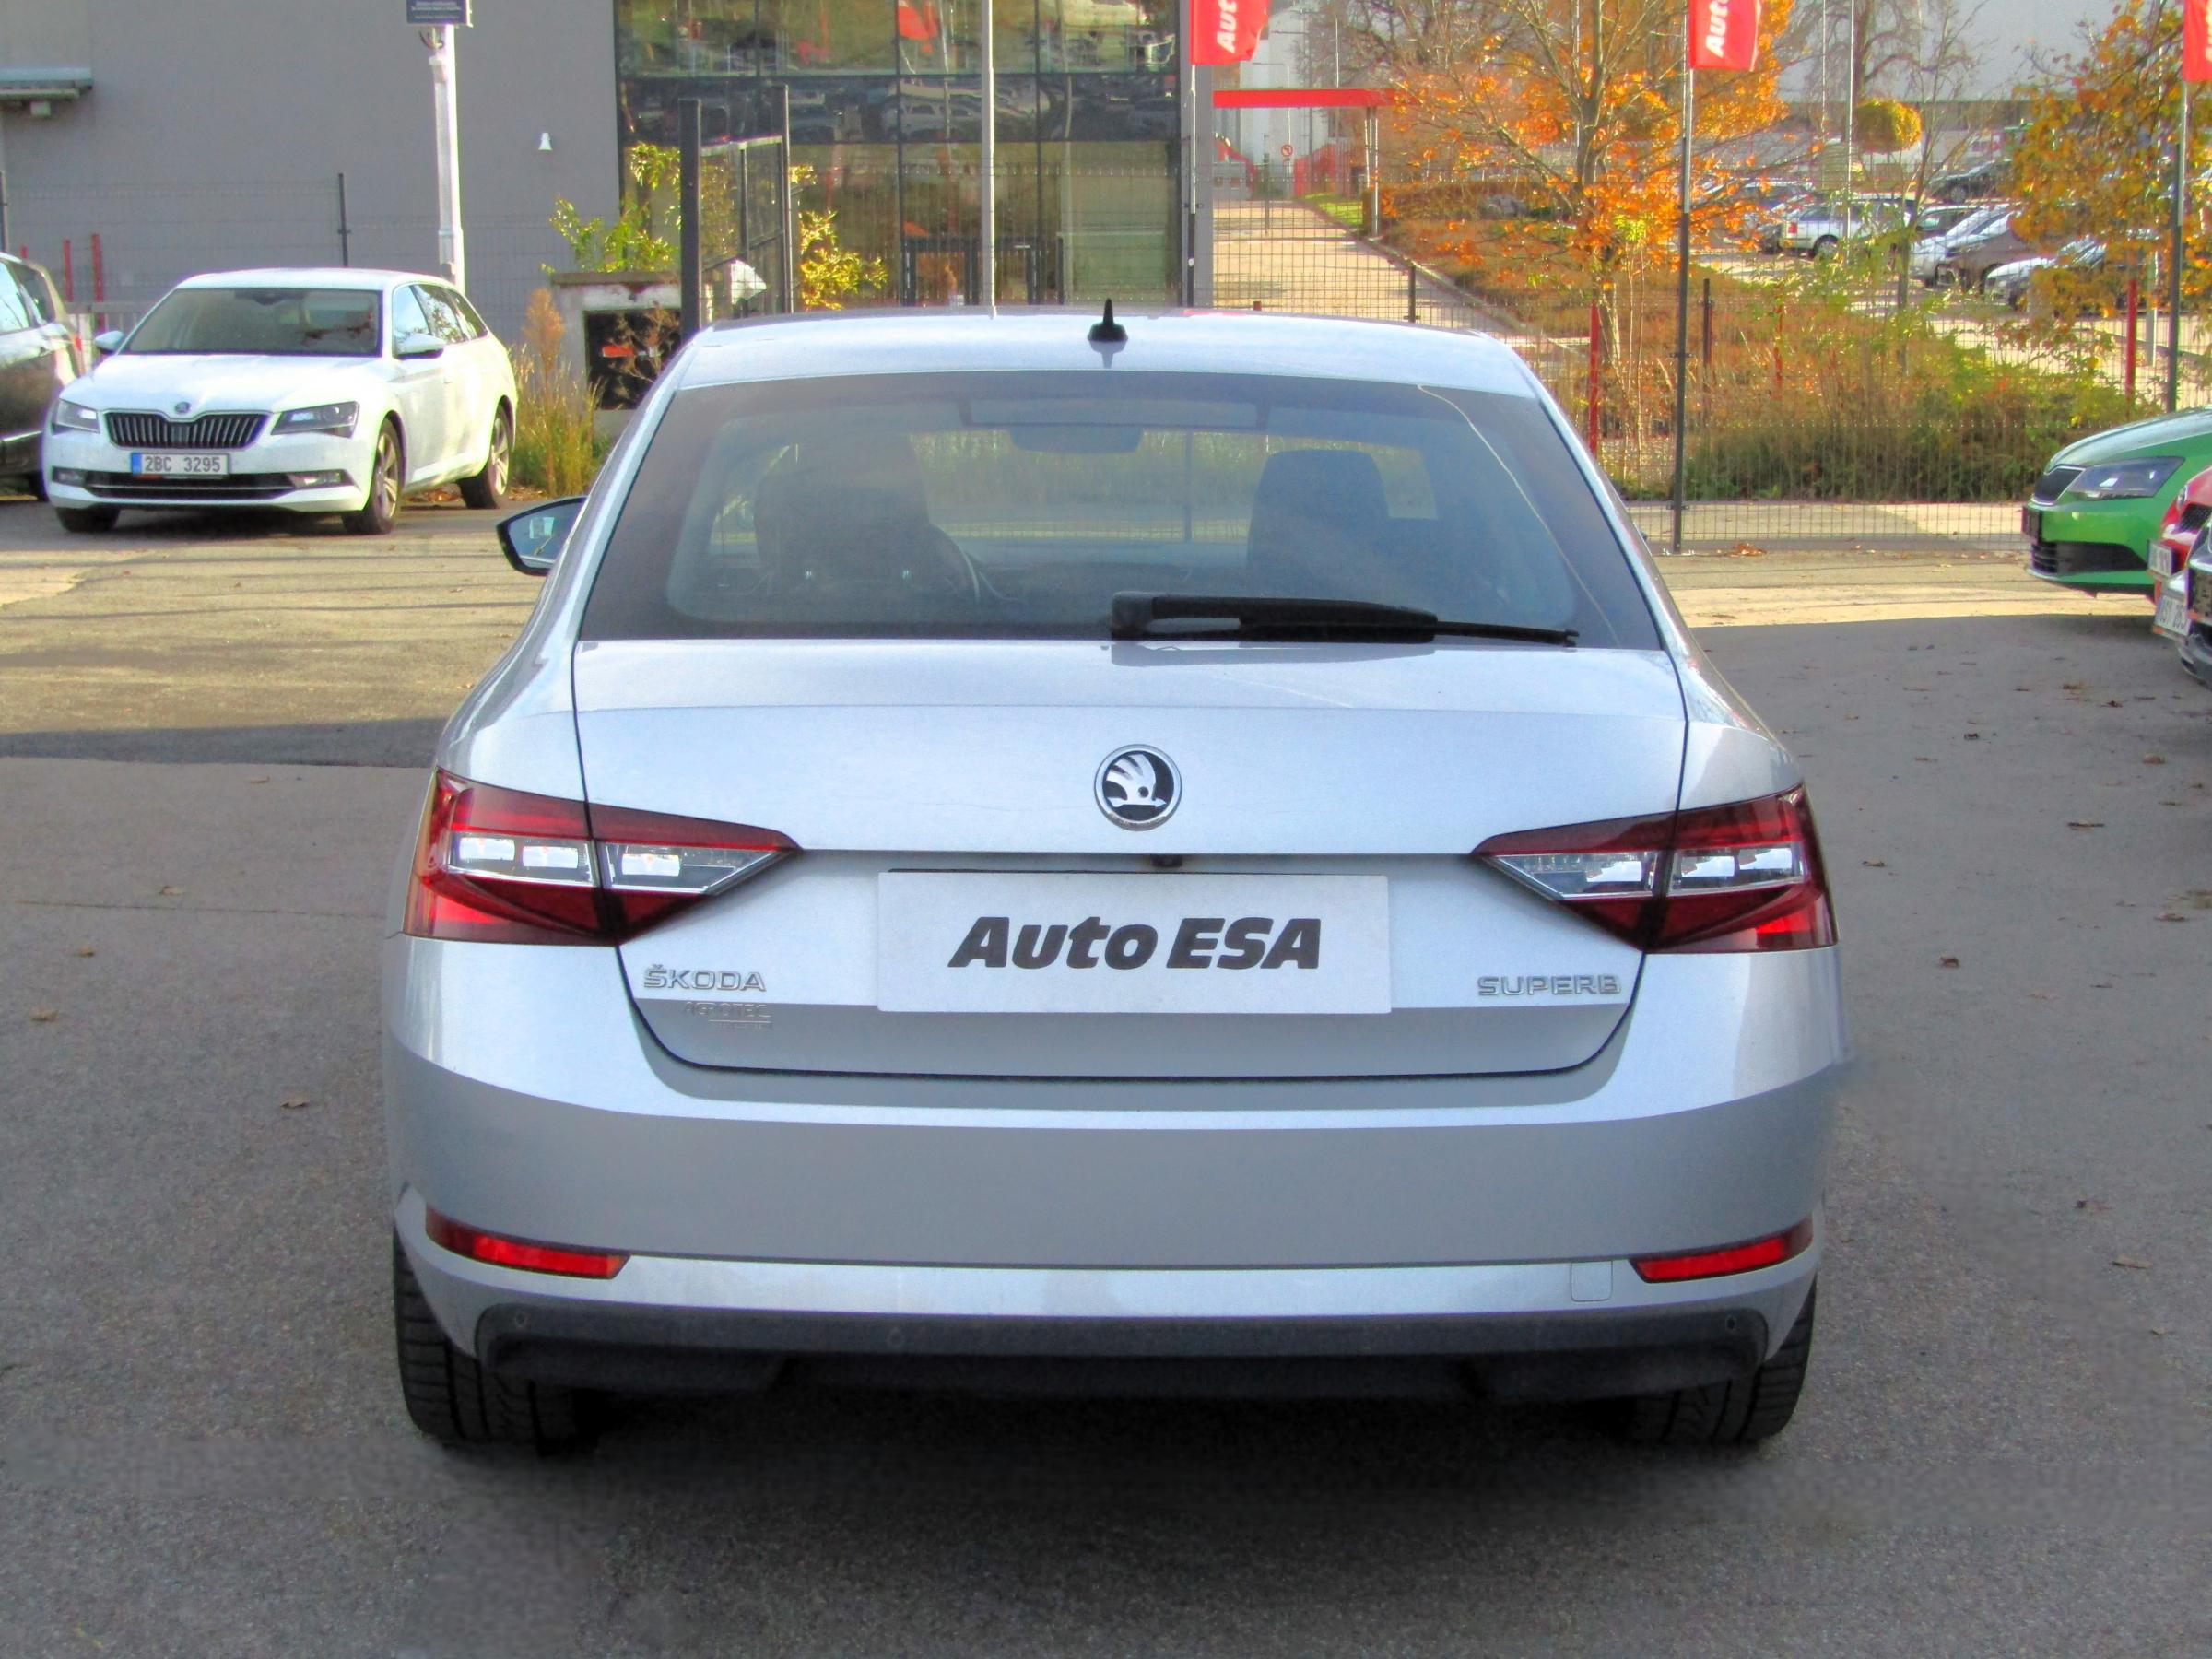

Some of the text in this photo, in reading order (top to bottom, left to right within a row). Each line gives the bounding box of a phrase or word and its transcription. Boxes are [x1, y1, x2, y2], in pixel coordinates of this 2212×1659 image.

[145, 456, 221, 473] 2BC 3295
[947, 916, 1321, 971] Auto ESA
[644, 964, 767, 993] ŠKODA
[1477, 974, 1622, 996] SUPERB
